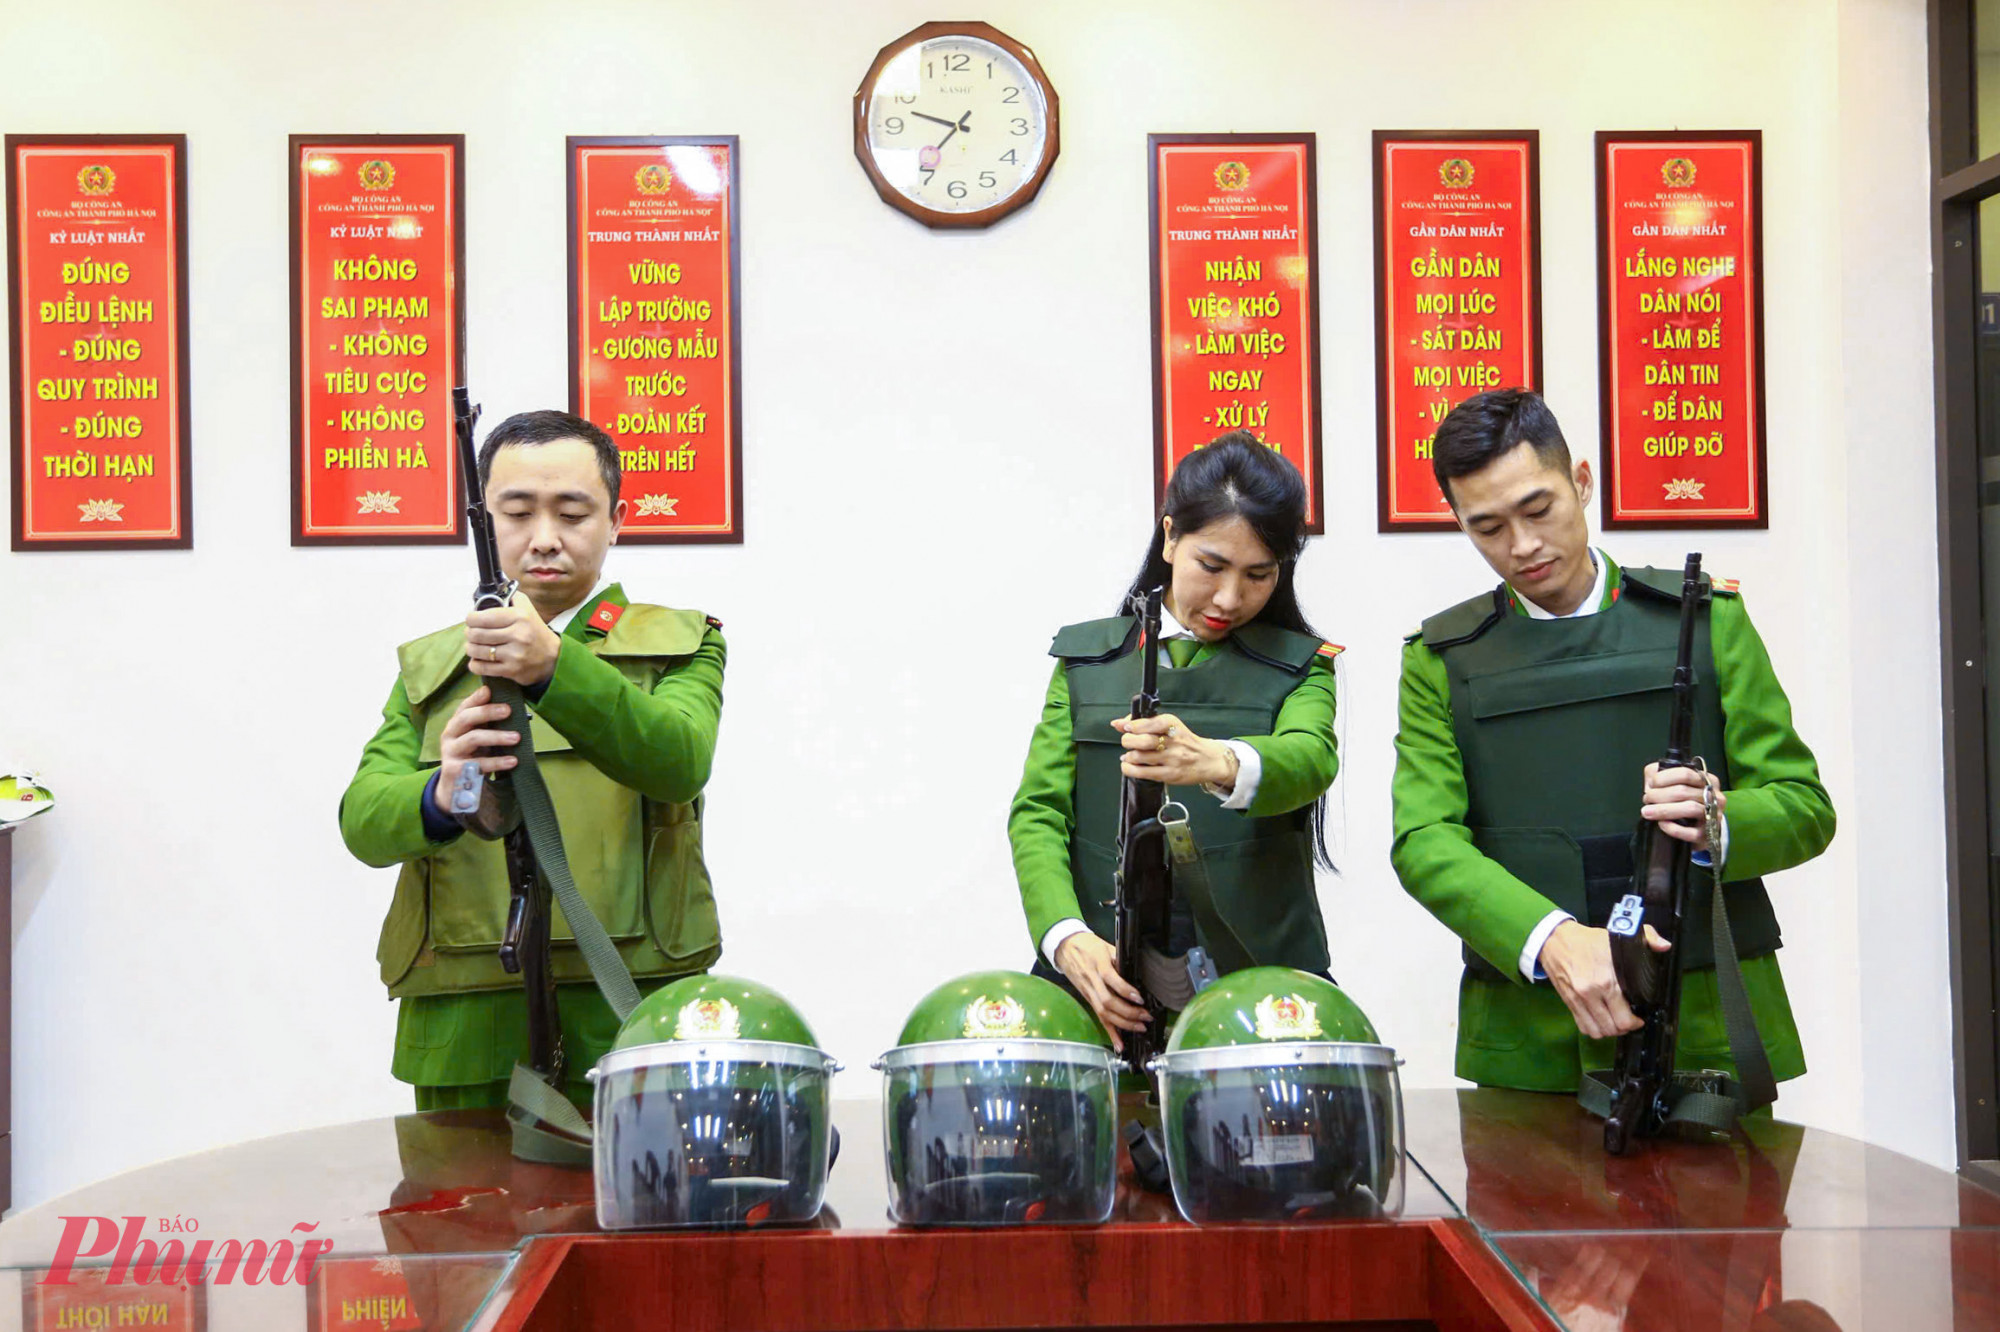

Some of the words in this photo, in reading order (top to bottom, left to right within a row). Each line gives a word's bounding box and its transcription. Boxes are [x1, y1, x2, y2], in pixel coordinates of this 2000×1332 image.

[943, 54, 971, 71] 12
[986, 62, 992, 79] 1
[1002, 87, 1020, 103] 2
[885, 118, 904, 134] 9
[1010, 119, 1029, 135] 3
[999, 149, 1018, 165] 4
[919, 168, 936, 185] 7
[947, 181, 968, 198] 6
[979, 172, 997, 187] 5
[49, 230, 67, 243] KỶ
[71, 230, 104, 246] LUẬT
[108, 227, 145, 243] NHẤT
[330, 223, 347, 238] KỶ
[351, 224, 383, 240] LUẬT
[588, 231, 631, 242] TRUNG
[635, 228, 680, 242] THÀNH
[684, 225, 720, 241] NHẤT
[1169, 230, 1211, 240] TRUNG
[1214, 227, 1259, 240] THÀNH
[1262, 224, 1297, 239] NHẤT
[1409, 221, 1436, 237] GẦN
[1440, 224, 1466, 237] DÂN
[1470, 221, 1504, 237] NHẤT
[1632, 221, 1658, 236] GẦN
[1692, 220, 1727, 236] NHẤT
[63, 257, 129, 283] ĐÚNG
[334, 254, 416, 280] KHÔNG
[629, 259, 680, 284] VỮNG
[1206, 256, 1260, 286] NHẬN
[1411, 248, 1453, 277] GẦN
[1460, 252, 1499, 277] DÂN
[1627, 248, 1676, 276] LẮNG
[1684, 257, 1733, 276] NGHE
[40, 291, 90, 322] ĐIỀU
[99, 295, 152, 328] LỆNH
[322, 297, 355, 318] SAI
[364, 297, 427, 323] PHẠM
[600, 296, 632, 327] LẬP
[637, 295, 710, 321] TRƯỜNG
[1188, 292, 1232, 324] VIỆC
[1238, 291, 1279, 317] KHÓ
[1417, 294, 1453, 319] MỌI
[1460, 288, 1495, 313] LÚC
[1641, 288, 1679, 312] DÂN
[1687, 288, 1720, 312] NÓI
[344, 329, 427, 355] KHÔNG
[603, 336, 672, 359] GƯƠNG
[678, 329, 717, 358] MẪU
[1196, 329, 1234, 354] LÀM
[1240, 328, 1284, 359] VIỆC
[1422, 325, 1455, 349] SÁT
[1461, 325, 1500, 349] DÂN
[1654, 324, 1690, 348] LÀM
[1698, 319, 1720, 347] ĐỂ
[74, 334, 140, 360] ĐÚNG
[325, 367, 368, 392] TIÊU
[376, 370, 426, 399] CỰC
[625, 370, 686, 396] TRƯỚC
[1210, 370, 1262, 390] NGAY
[1415, 367, 1450, 392] MỌI
[1457, 362, 1499, 391] VIỆC
[1646, 360, 1684, 384] DÂN
[1691, 365, 1718, 384] TIN
[38, 379, 85, 399] QUY
[93, 372, 157, 399] TRÌNH
[342, 404, 424, 430] KHÔNG
[617, 407, 670, 433] ĐOÀN
[677, 404, 706, 433] KẾT
[1216, 400, 1242, 426] XỬ
[1249, 401, 1268, 426] LÝ
[1654, 391, 1676, 420] ĐỂ
[1683, 396, 1721, 419] DÂN
[75, 411, 141, 438] ĐÚNG
[326, 437, 388, 468] PHIỀN
[397, 441, 428, 468] HÀ
[619, 445, 659, 470] TRÊN
[666, 442, 695, 470] HẾT
[1644, 432, 1688, 456] GIÚP
[1695, 432, 1722, 455] ĐỠ
[44, 450, 96, 476] THỜI
[105, 455, 152, 482] HẠN
